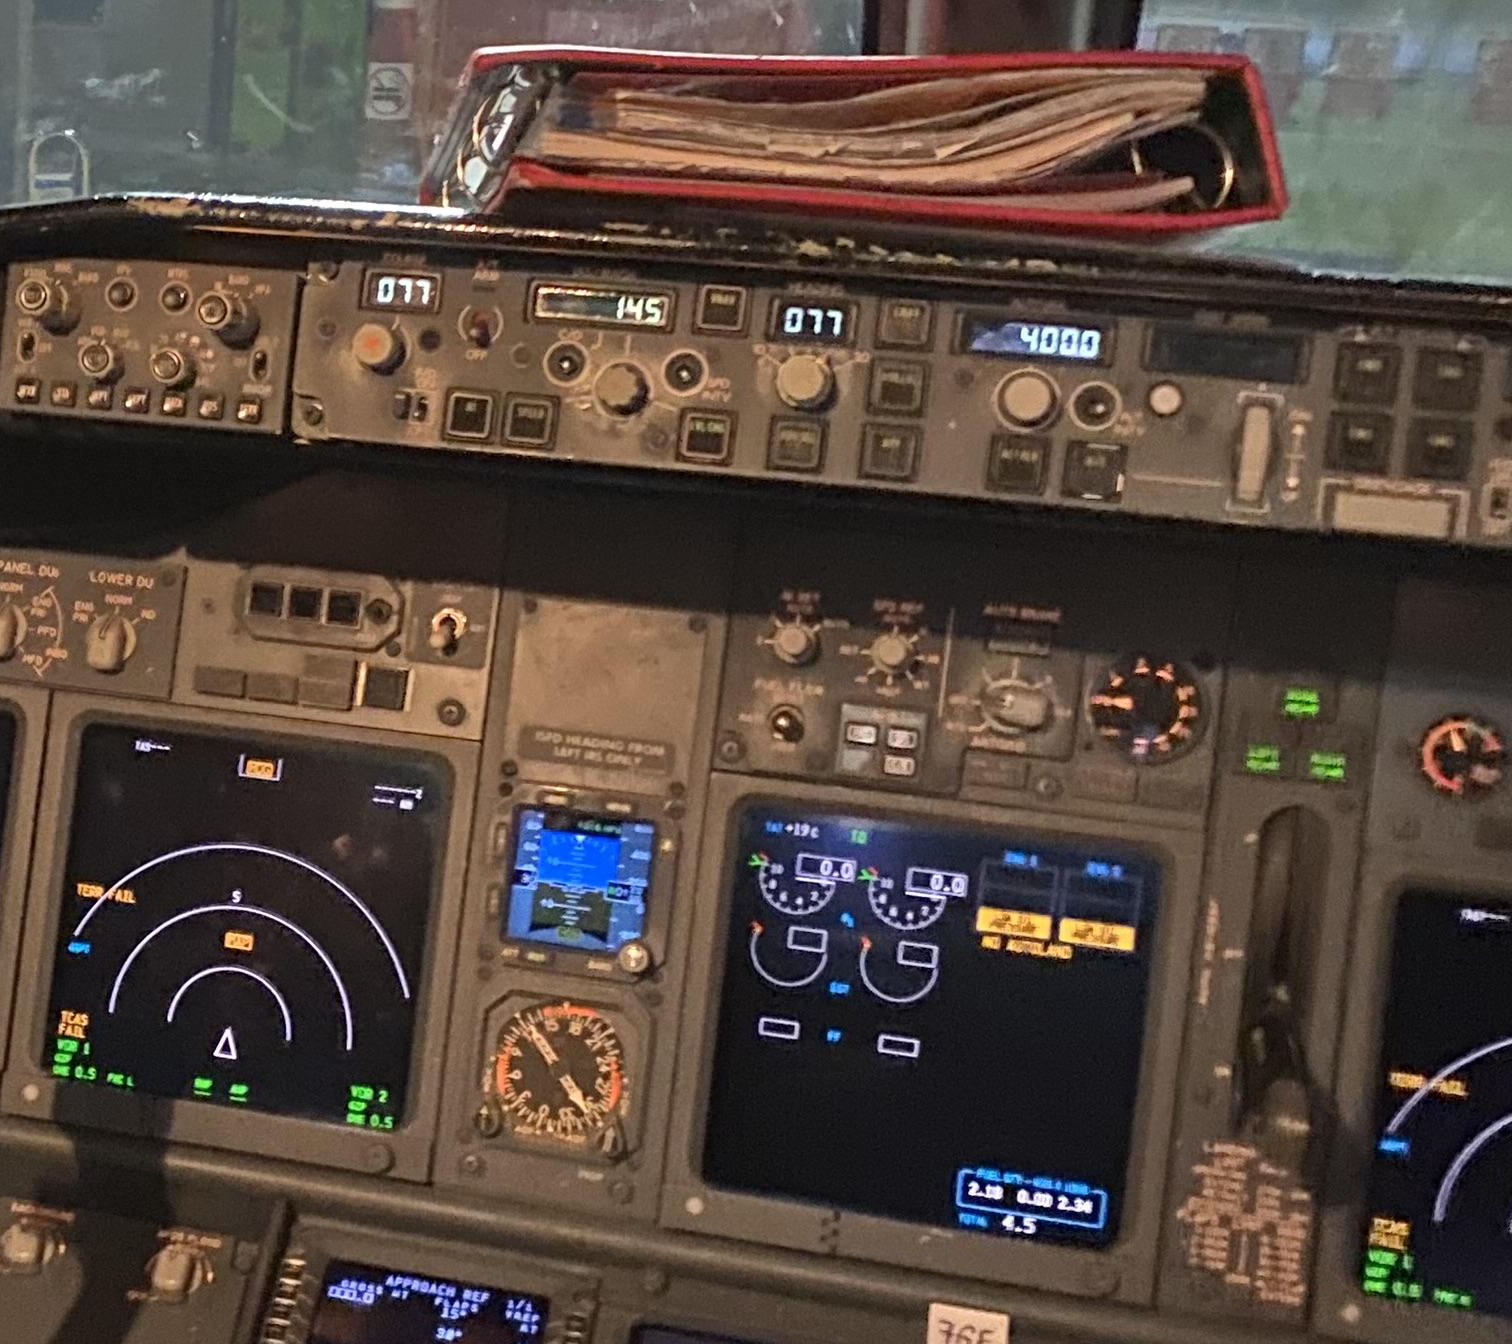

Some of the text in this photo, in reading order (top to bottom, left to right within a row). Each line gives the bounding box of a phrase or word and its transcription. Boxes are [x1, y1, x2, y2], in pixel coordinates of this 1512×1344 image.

[377, 276, 432, 304] 077
[616, 297, 662, 323] 145
[784, 307, 843, 336] 077
[1020, 326, 1101, 358] 4000
[90, 571, 133, 586] LOWER
[566, 734, 625, 751] HEADING
[819, 860, 854, 879] 0.0
[929, 873, 965, 894] 0.0
[60, 1010, 89, 1025] TCAS
[58, 1024, 86, 1038] FAIL
[369, 1114, 394, 1129] 0.5
[1002, 1214, 1037, 1234] 4.5
[385, 1275, 490, 1303] APPROACH REF
[434, 1297, 479, 1314] FLAPS
